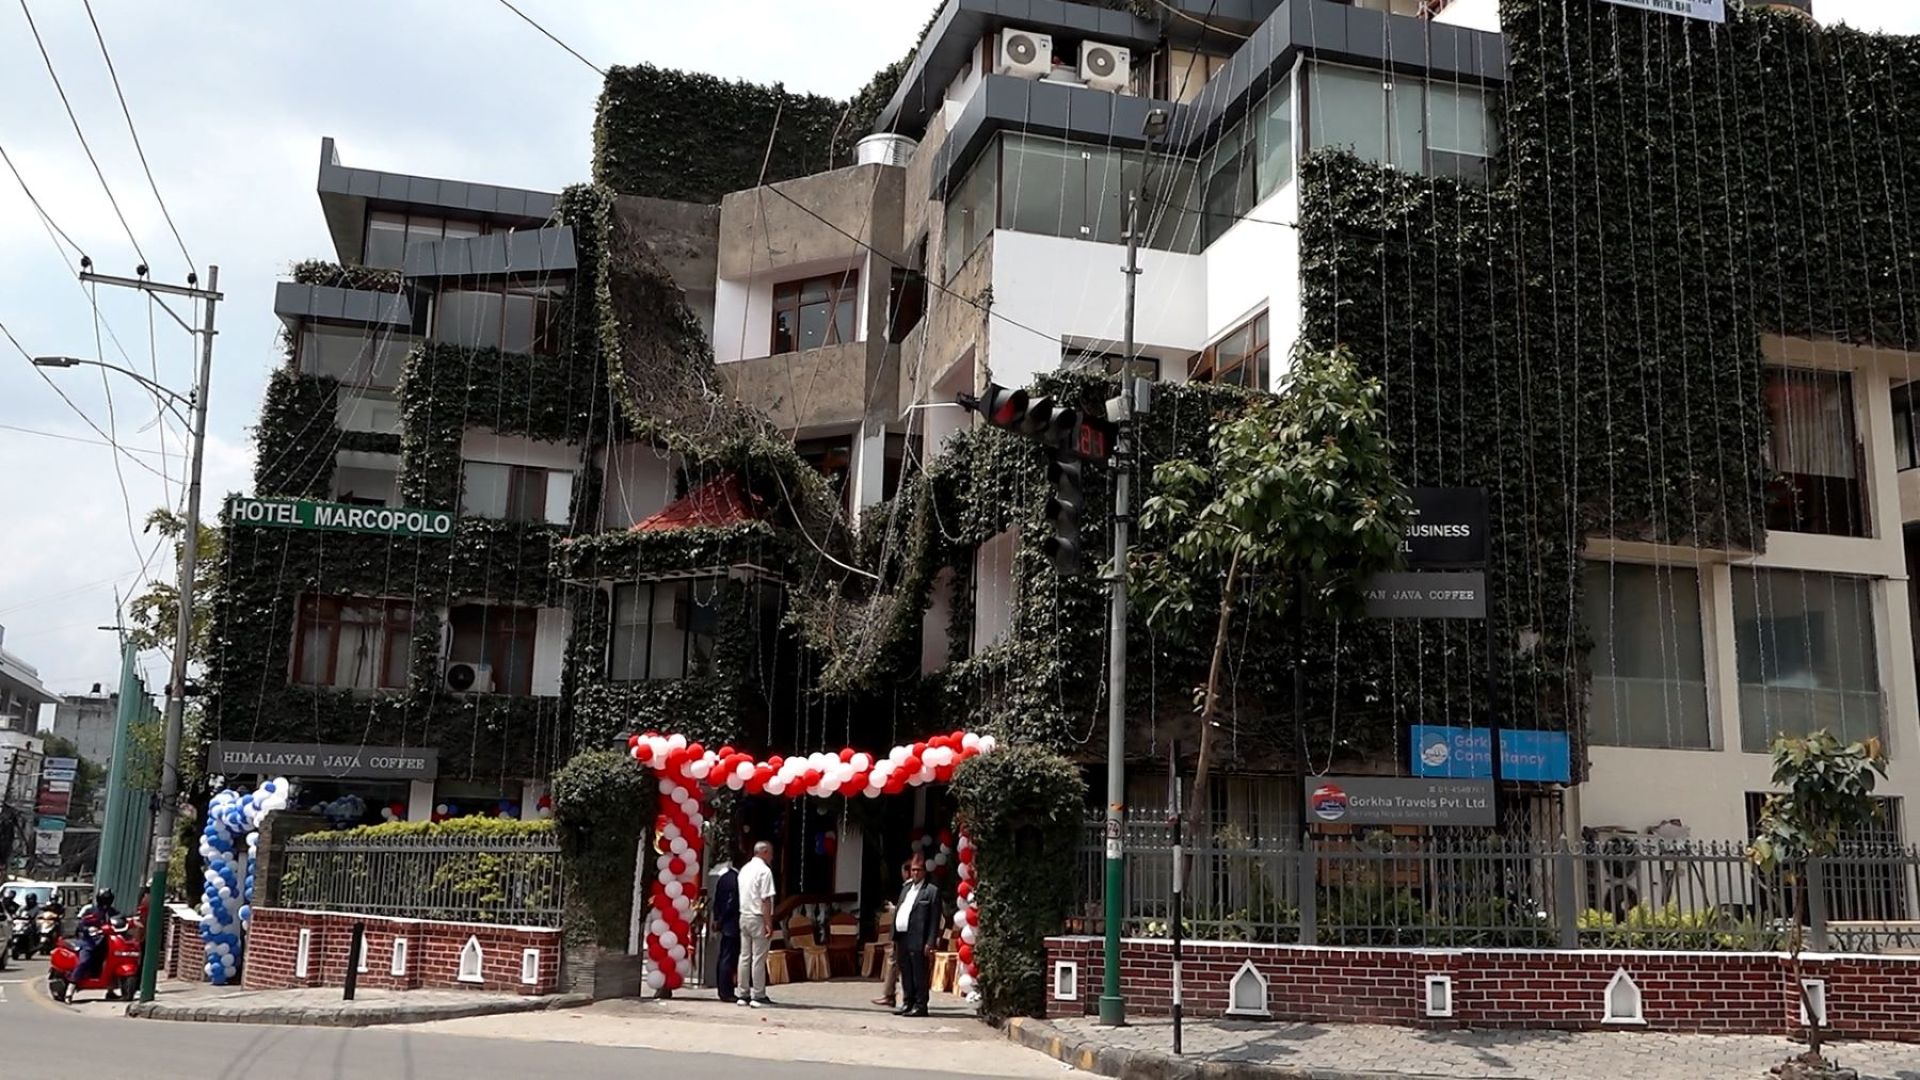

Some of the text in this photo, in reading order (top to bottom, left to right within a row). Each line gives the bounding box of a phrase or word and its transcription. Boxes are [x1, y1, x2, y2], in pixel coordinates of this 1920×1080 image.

[231, 500, 451, 534] HOTEL MARCOPOLO
[1392, 590, 1423, 600] JAVA
[1428, 590, 1475, 600] COFFEE
[1454, 735, 1507, 748] Gorka
[223, 751, 425, 770] HIMALAYAN JAVA COFFEE
[1454, 749, 1546, 766] Consltancy
[1349, 795, 1489, 809] Gorkha Travels Pvt. Ltd.
